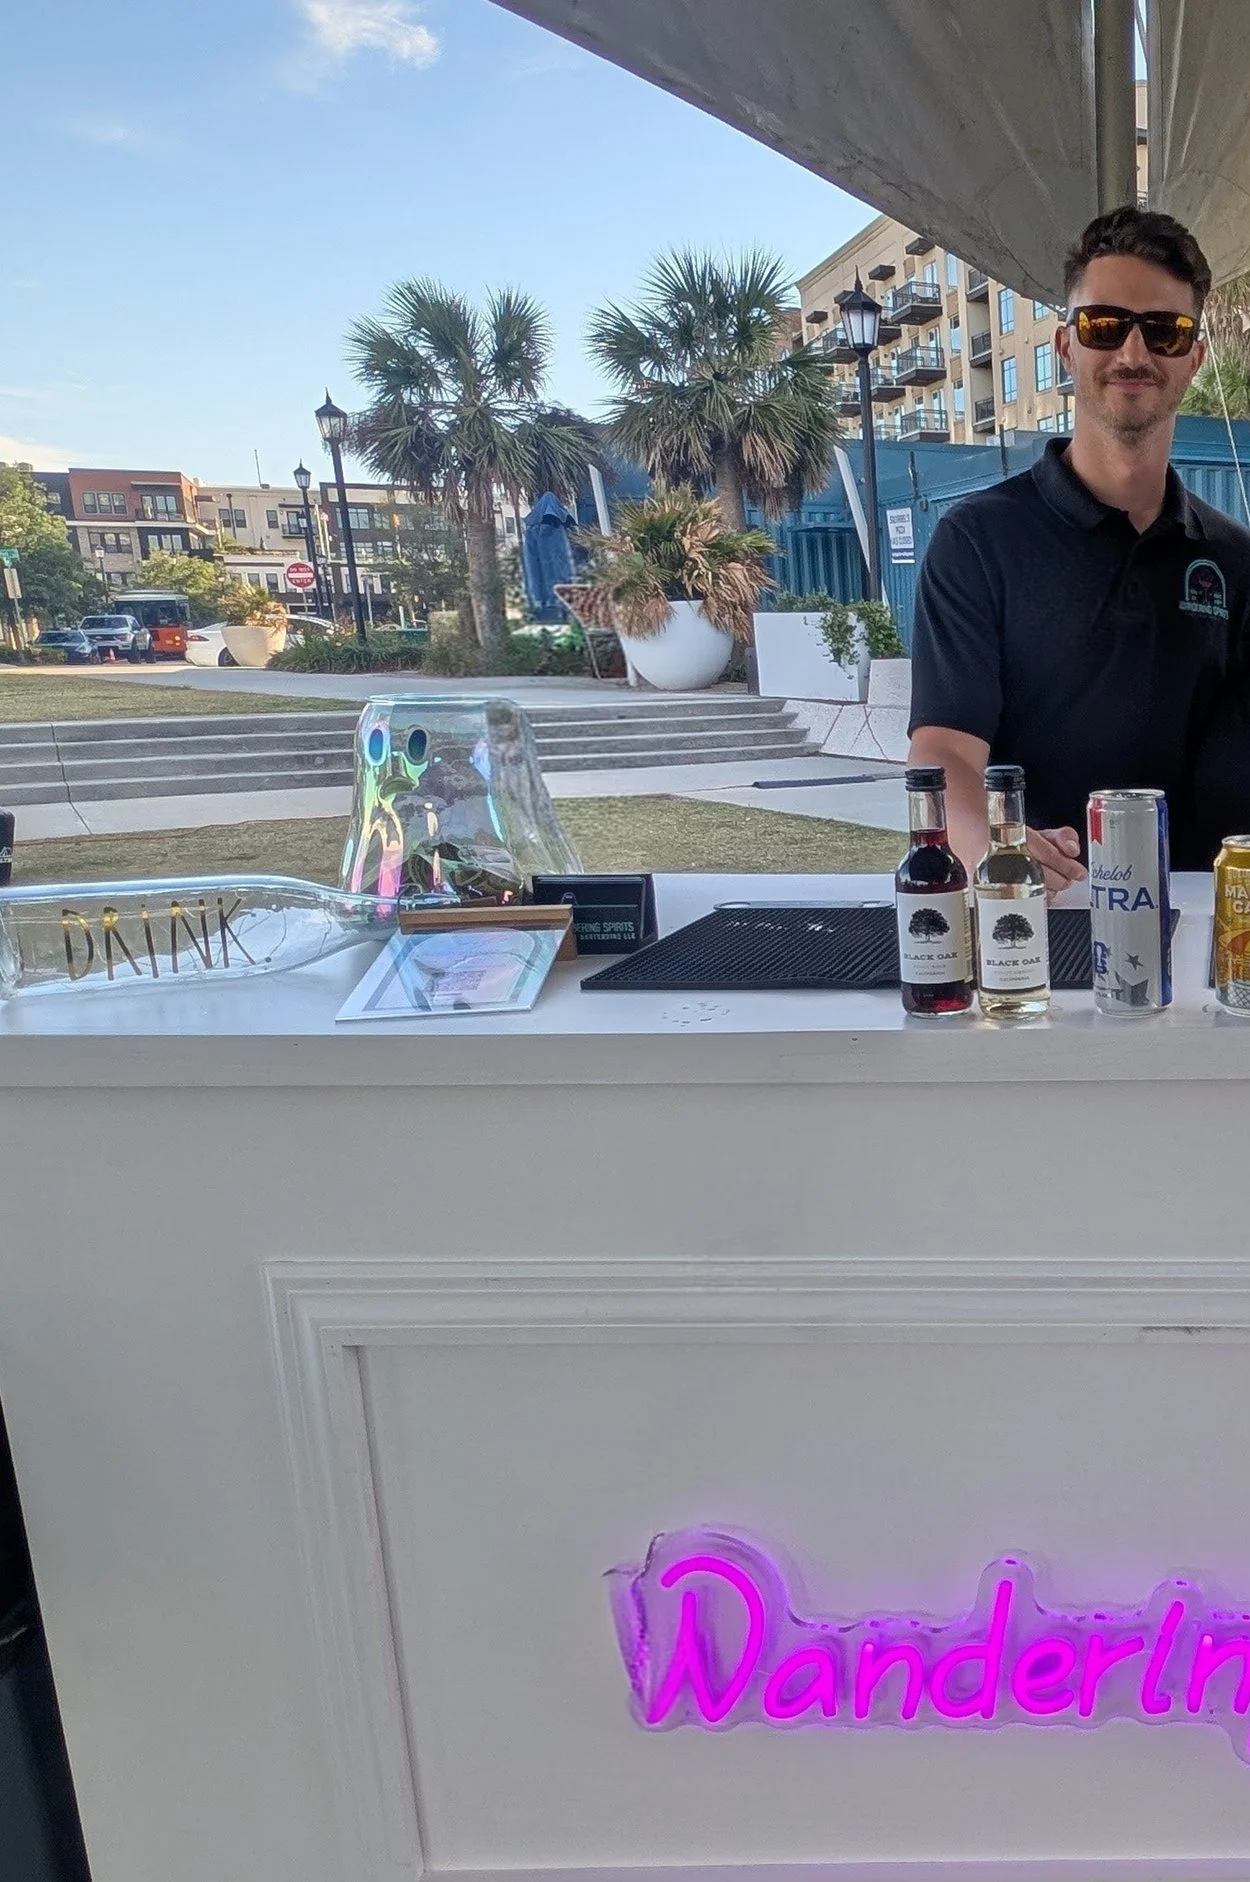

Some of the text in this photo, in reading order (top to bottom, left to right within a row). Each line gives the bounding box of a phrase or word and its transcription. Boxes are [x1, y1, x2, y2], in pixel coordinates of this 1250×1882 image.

[1092, 863, 1133, 881] chelob
[1090, 884, 1156, 912] TRA
[603, 922, 634, 932] SPIRITS
[904, 951, 959, 961] BLACK OAK
[985, 955, 1042, 967] BLACK OAK
